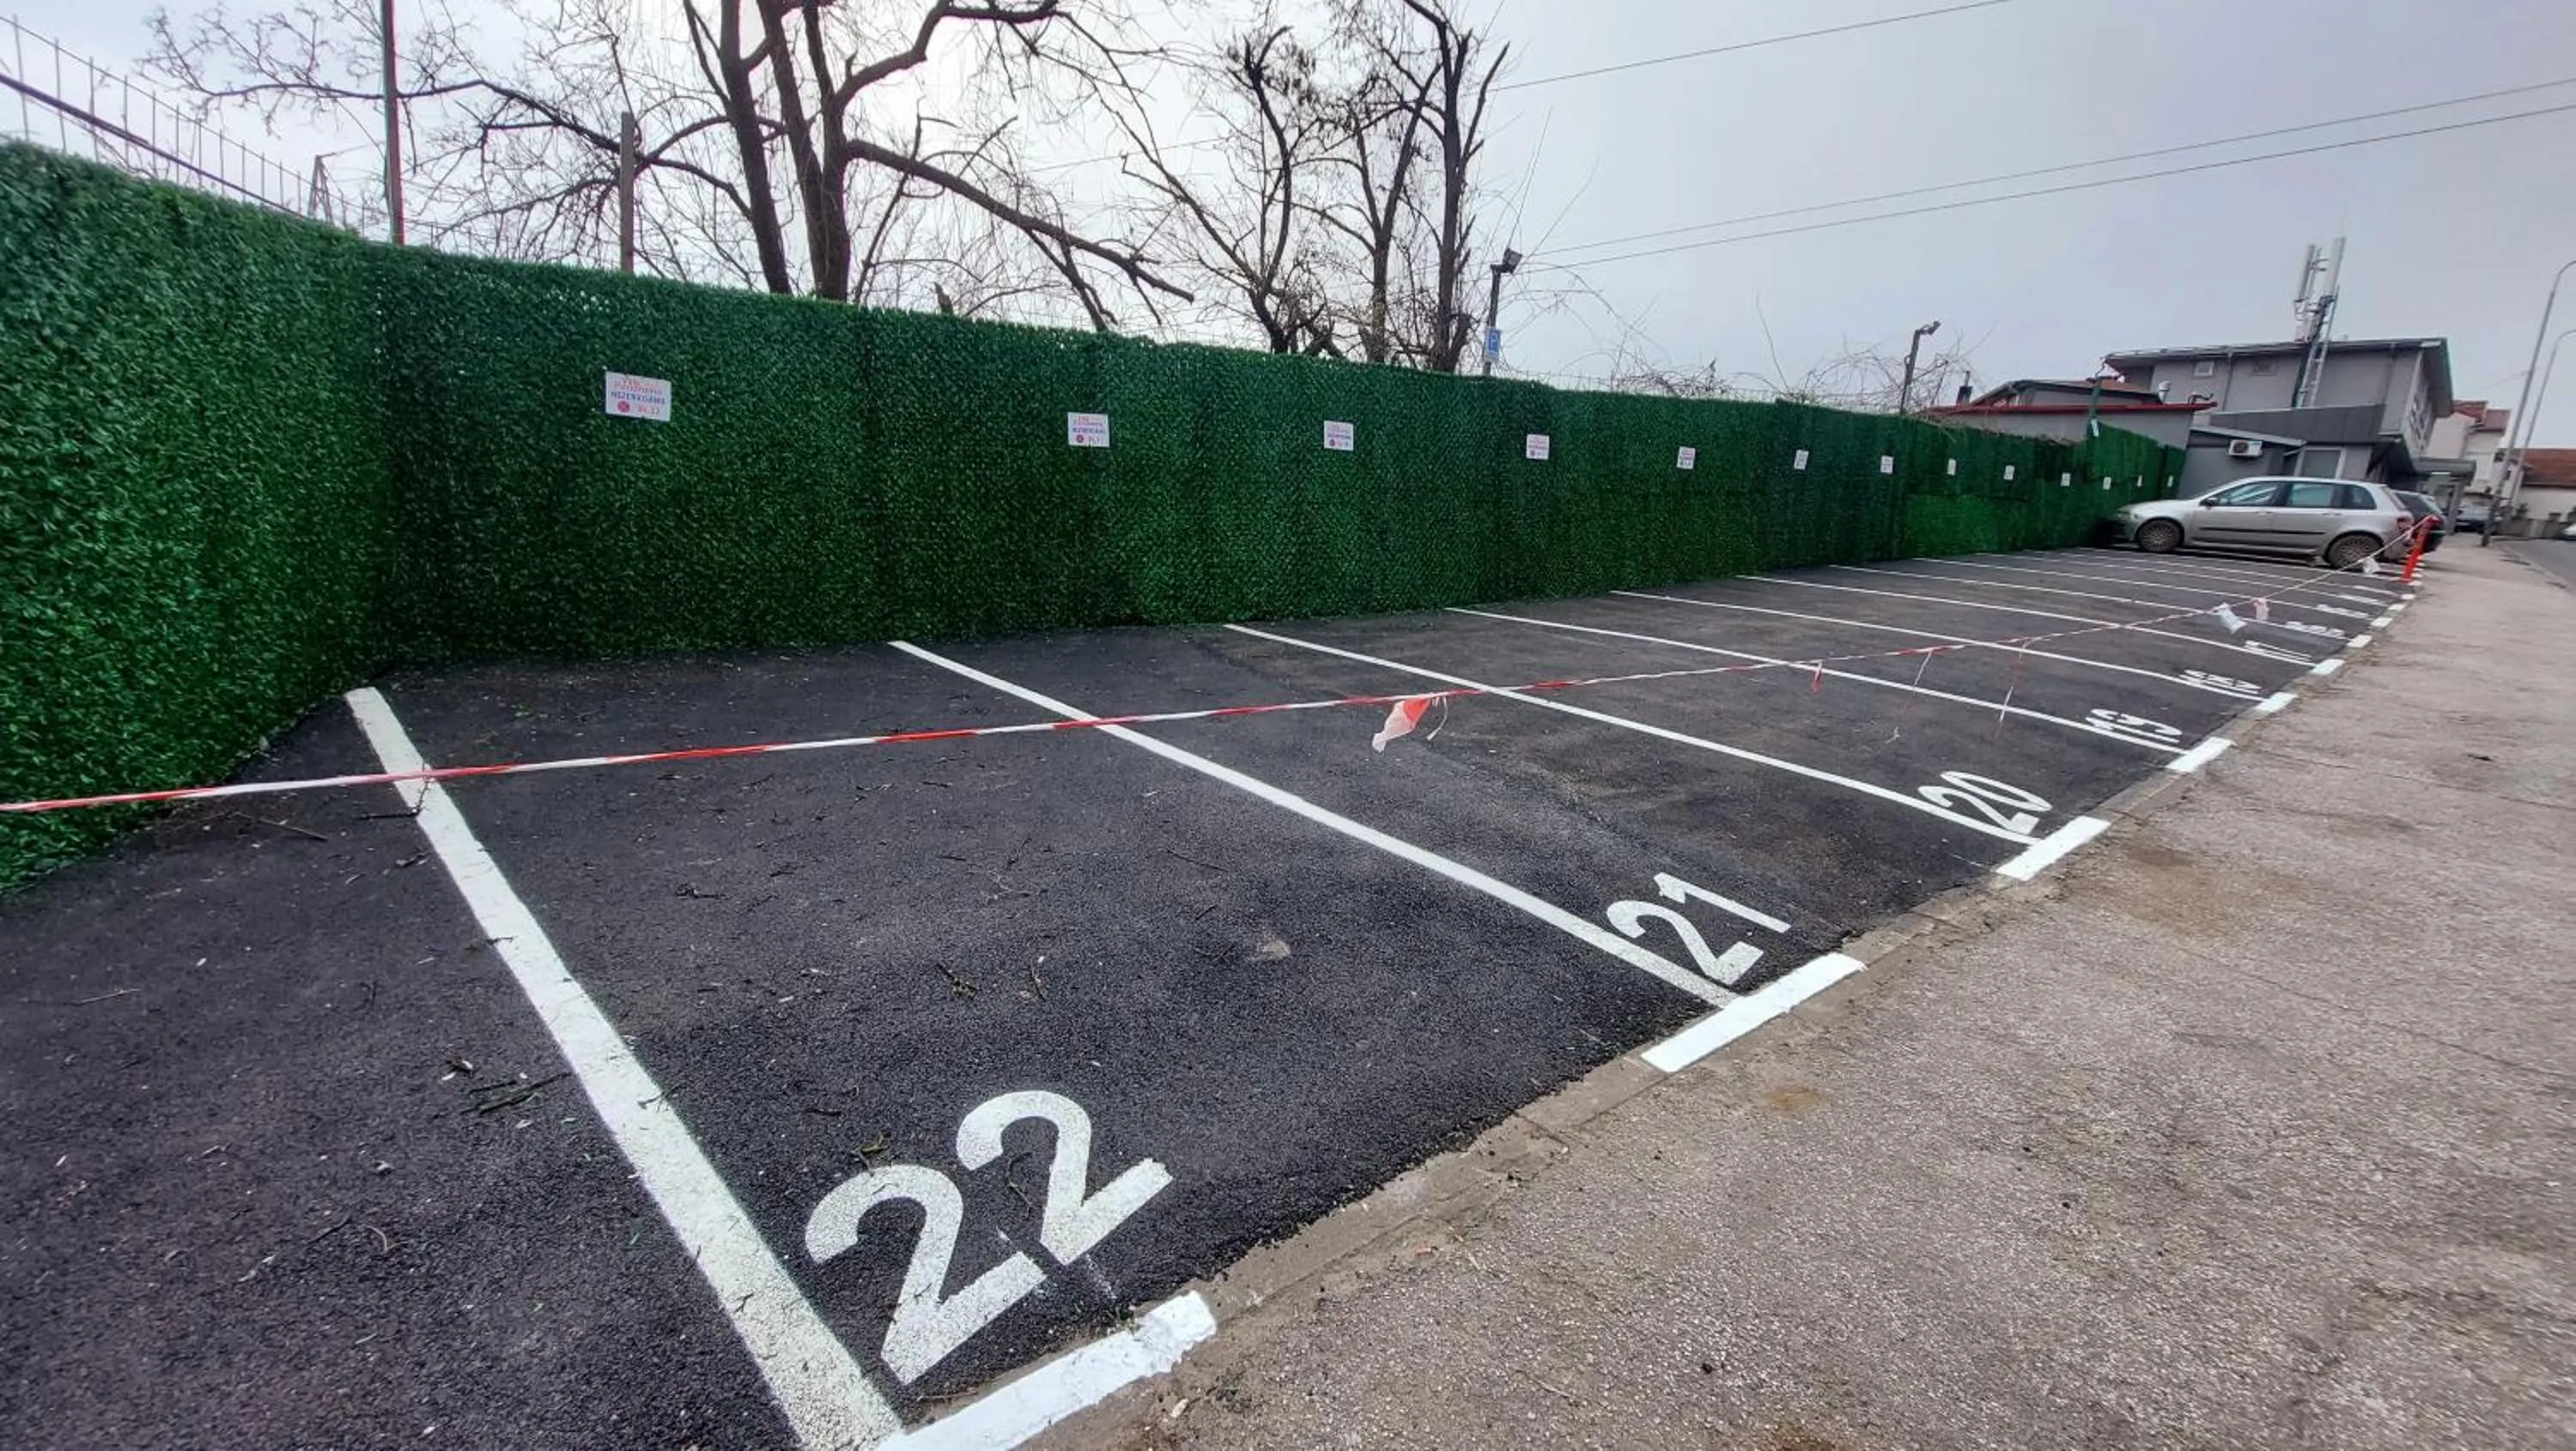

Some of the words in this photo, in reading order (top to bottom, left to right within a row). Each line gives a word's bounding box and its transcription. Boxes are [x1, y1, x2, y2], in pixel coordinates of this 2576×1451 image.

[2178, 669, 2263, 695] 18
[2085, 708, 2184, 744] 19
[1917, 771, 2053, 835] 20
[1607, 872, 1792, 985] 21
[805, 1090, 1174, 1386] 22
